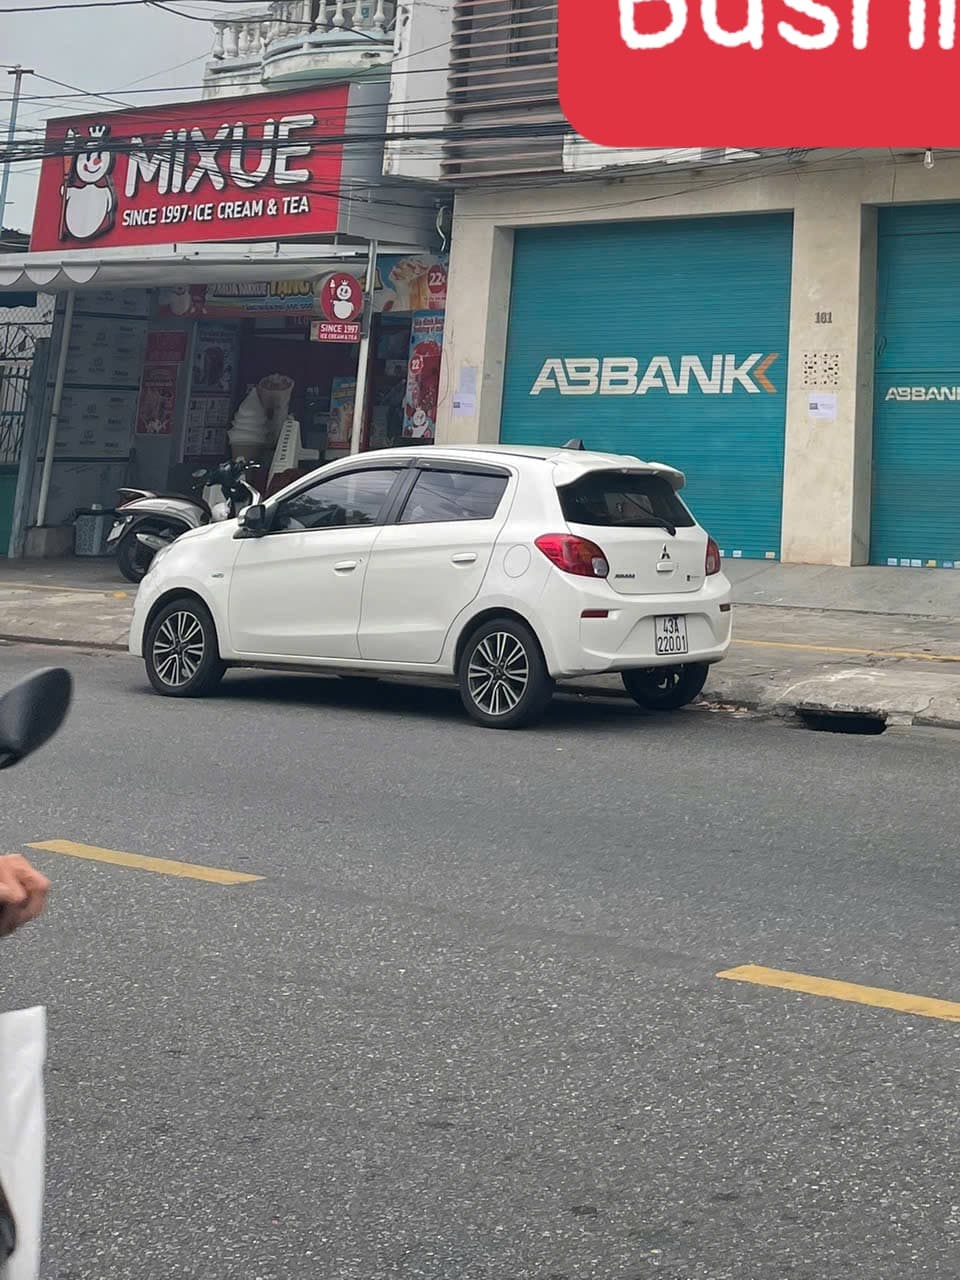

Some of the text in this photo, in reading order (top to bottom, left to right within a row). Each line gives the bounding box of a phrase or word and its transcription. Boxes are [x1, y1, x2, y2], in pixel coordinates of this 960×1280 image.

[125, 114, 315, 197] MIXUE
[122, 208, 156, 226] SINCE
[217, 199, 263, 219] CREAM
[266, 198, 278, 215] &
[282, 196, 309, 214] TEA
[320, 323, 343, 333] SINCE
[529, 353, 763, 395] ABBANK
[663, 618, 680, 634] 43A
